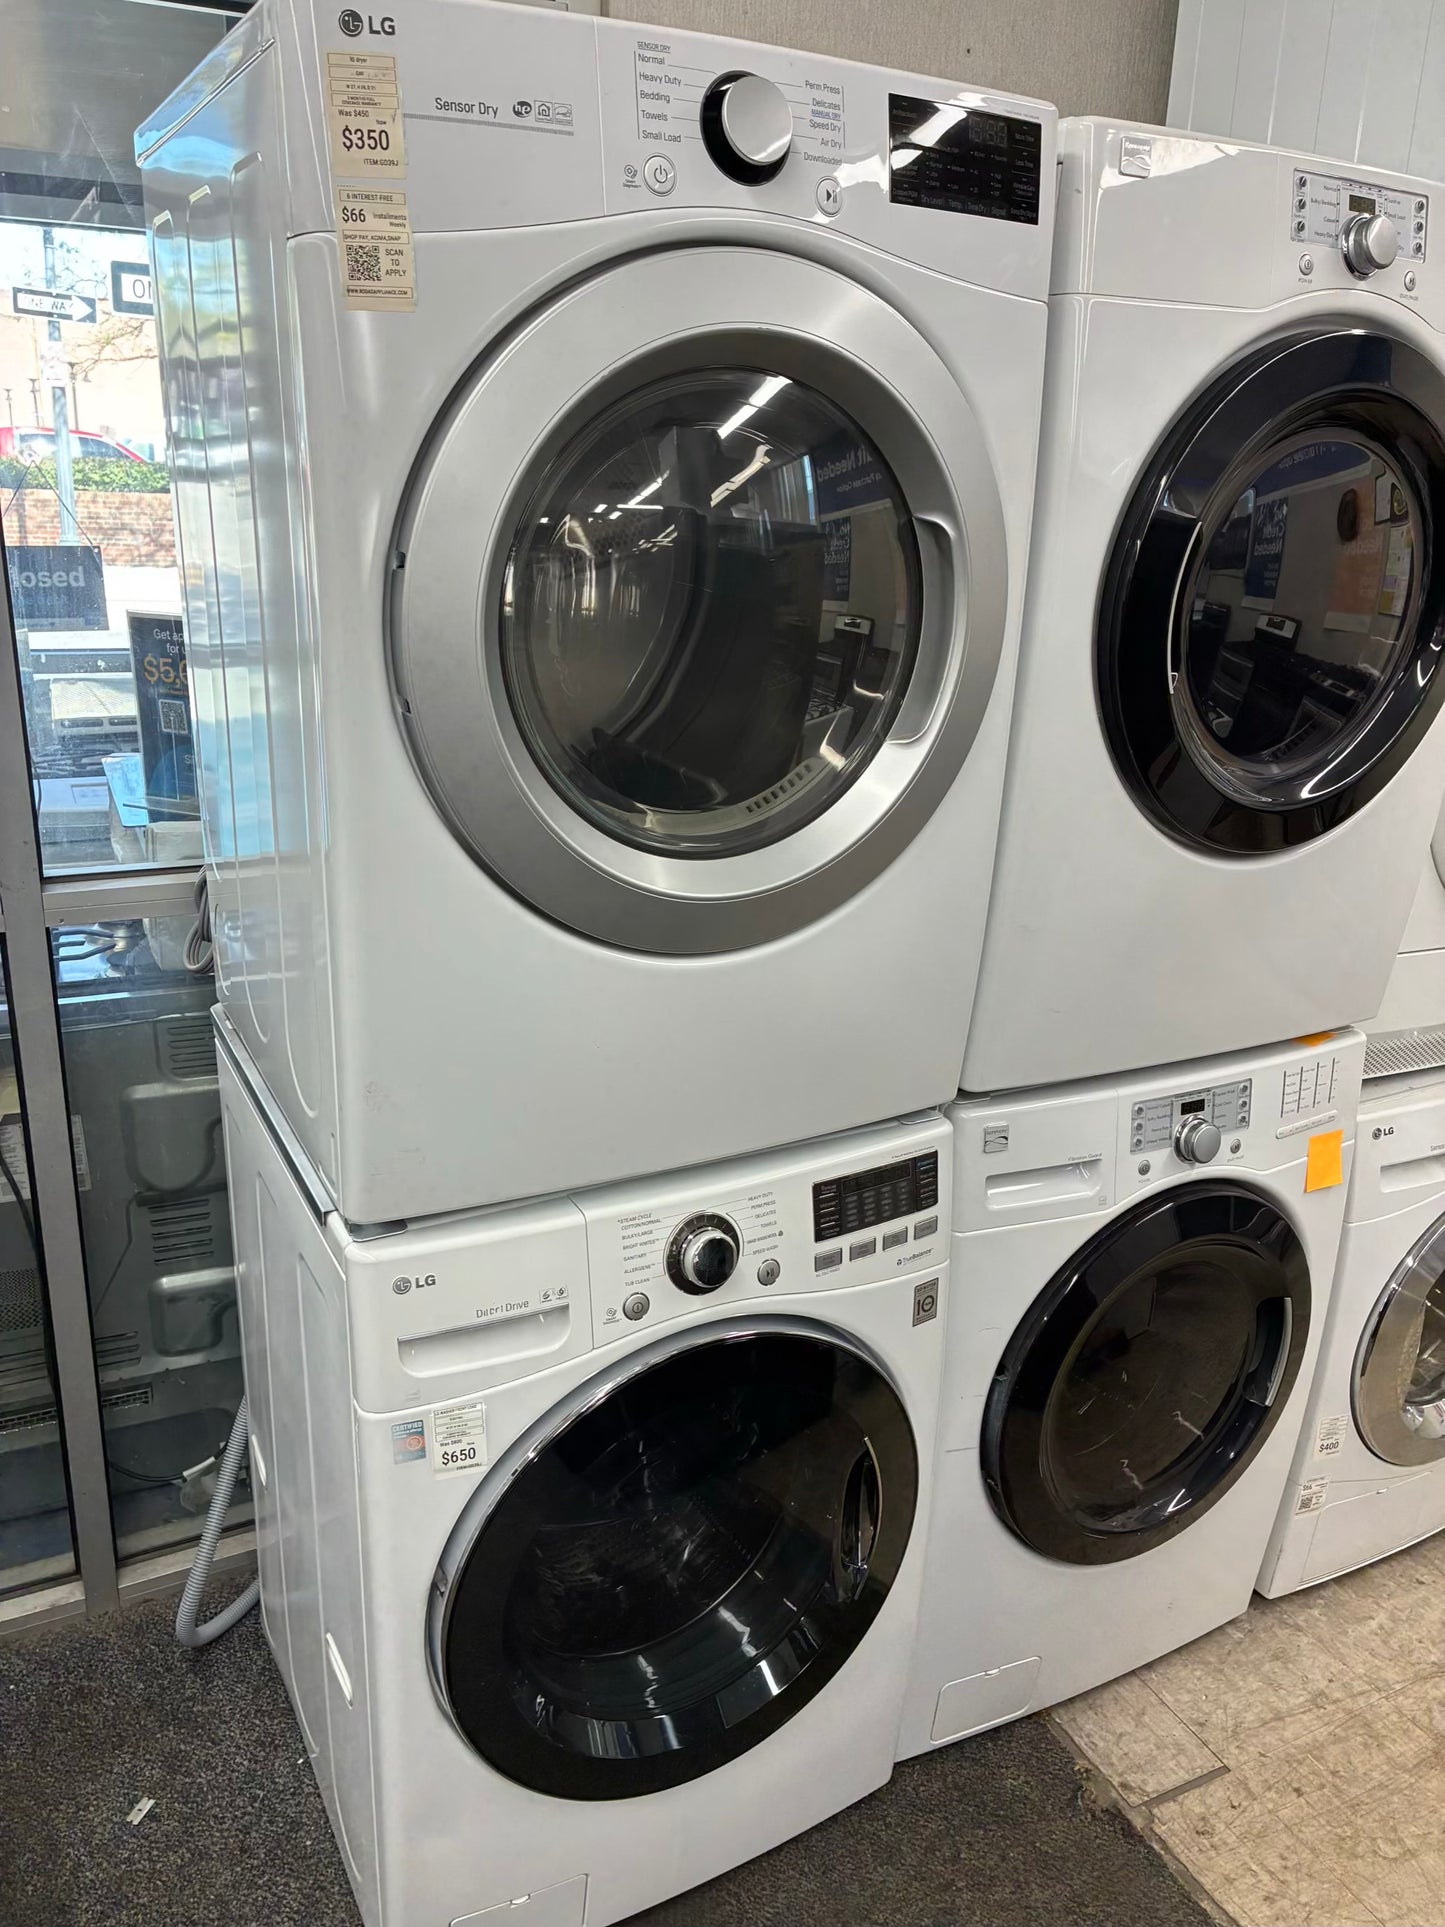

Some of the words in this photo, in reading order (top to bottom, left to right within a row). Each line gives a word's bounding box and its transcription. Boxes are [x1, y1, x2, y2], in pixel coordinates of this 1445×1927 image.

[368, 15, 395, 36] LG
[637, 41, 658, 50] SENSOR
[658, 43, 671, 52] DRY
[638, 54, 665, 65] Normal
[639, 72, 663, 84] Heavy
[665, 75, 682, 86] Duty
[822, 85, 841, 95] Press
[640, 90, 671, 104] Bedding
[435, 97, 475, 114] Sensor
[478, 102, 498, 119] Dry
[812, 97, 841, 111] Delicates
[338, 109, 352, 117] Was
[641, 110, 668, 121] Towels
[811, 108, 828, 118] MANUAL
[829, 112, 841, 120] DRY
[809, 119, 827, 132] Speed
[828, 123, 841, 133] Dry
[342, 125, 390, 151] $350
[642, 130, 663, 141] Small
[664, 131, 681, 143] Load
[820, 138, 830, 147] Air
[831, 140, 842, 150] Dry
[804, 152, 842, 166] Downloaded
[342, 206, 366, 223] $66
[389, 221, 406, 229] Weekly
[385, 248, 404, 256] SCAN
[391, 259, 400, 267] TO
[385, 269, 407, 277] APPLY
[132, 278, 152, 299] O
[153, 629, 171, 641] Get
[166, 643, 180, 656] for
[1383, 1127, 1394, 1136] LG
[623, 1252, 647, 1262] SANITARY
[415, 1274, 437, 1289] LG
[635, 1277, 650, 1285] CLEAN
[505, 1300, 530, 1313] Drive
[392, 1421, 422, 1432] CERTIFIED
[1319, 1441, 1340, 1453] $400
[441, 1447, 476, 1466] $650
